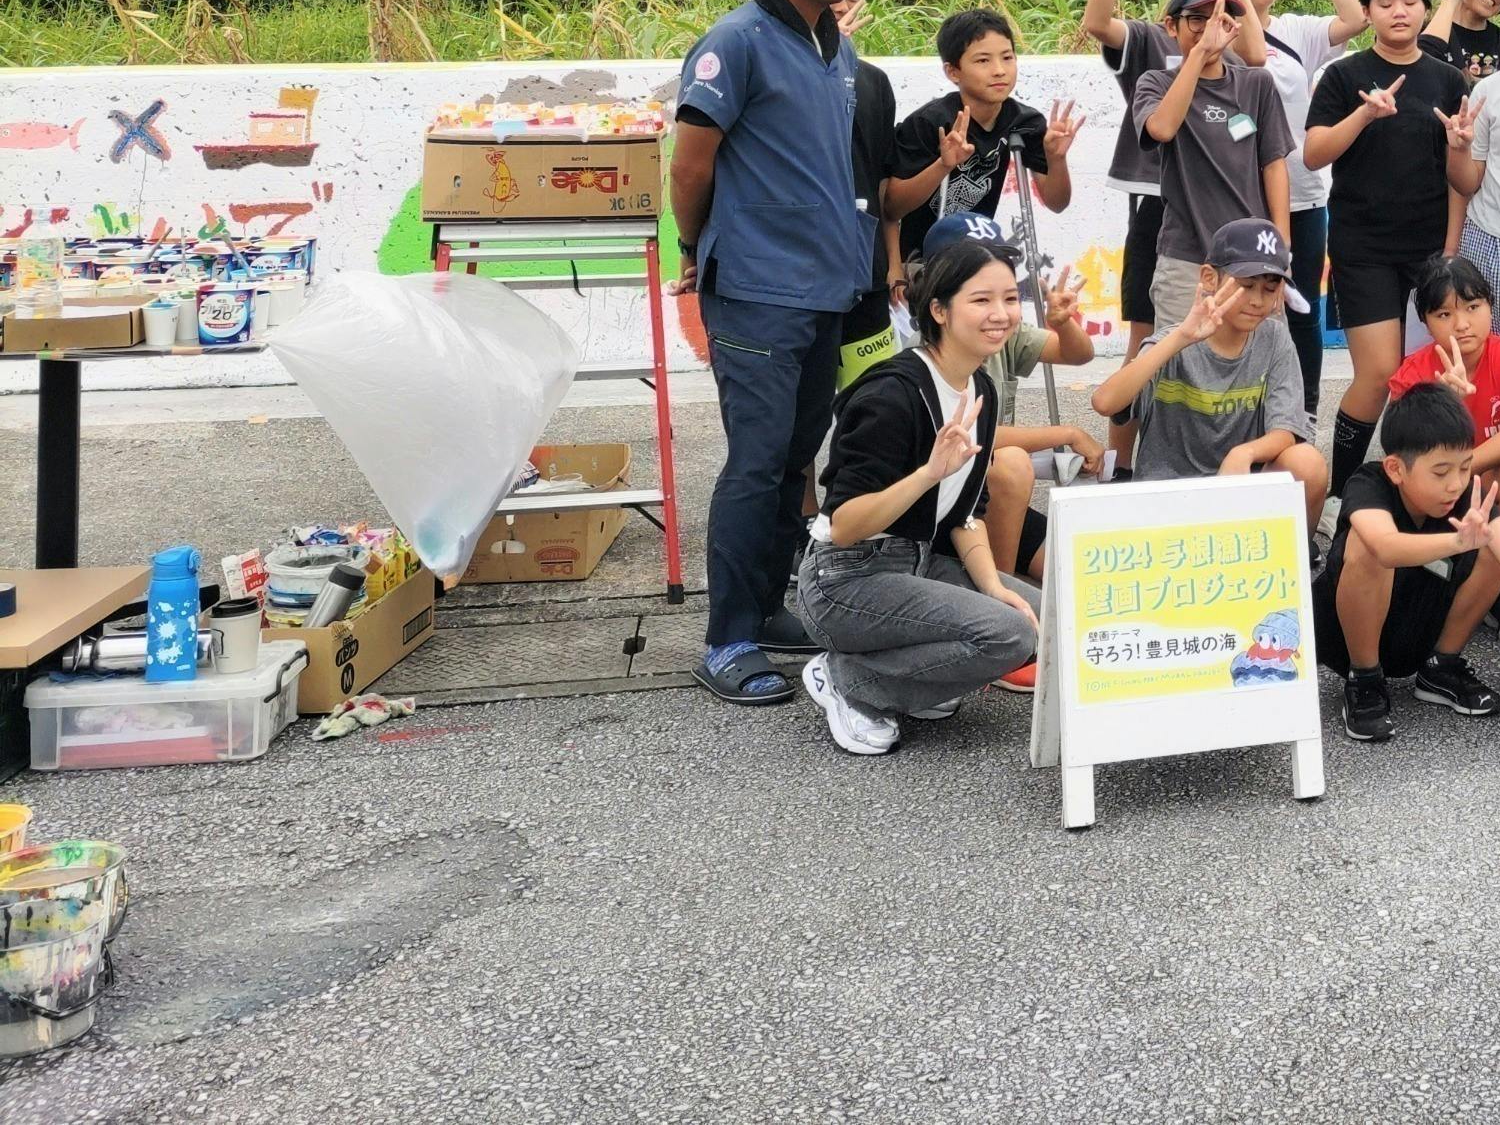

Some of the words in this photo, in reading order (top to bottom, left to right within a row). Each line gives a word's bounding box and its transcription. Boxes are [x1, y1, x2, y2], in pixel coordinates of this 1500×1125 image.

[1202, 110, 1227, 120] 100
[551, 170, 618, 194] Dole
[1256, 229, 1278, 256] NY
[212, 309, 231, 321] 20
[857, 335, 890, 357] GOING
[1083, 540, 1153, 574] 2024
[1085, 567, 1296, 618] 壁画プロジェクト
[1088, 628, 1141, 643] 壁画テーマ
